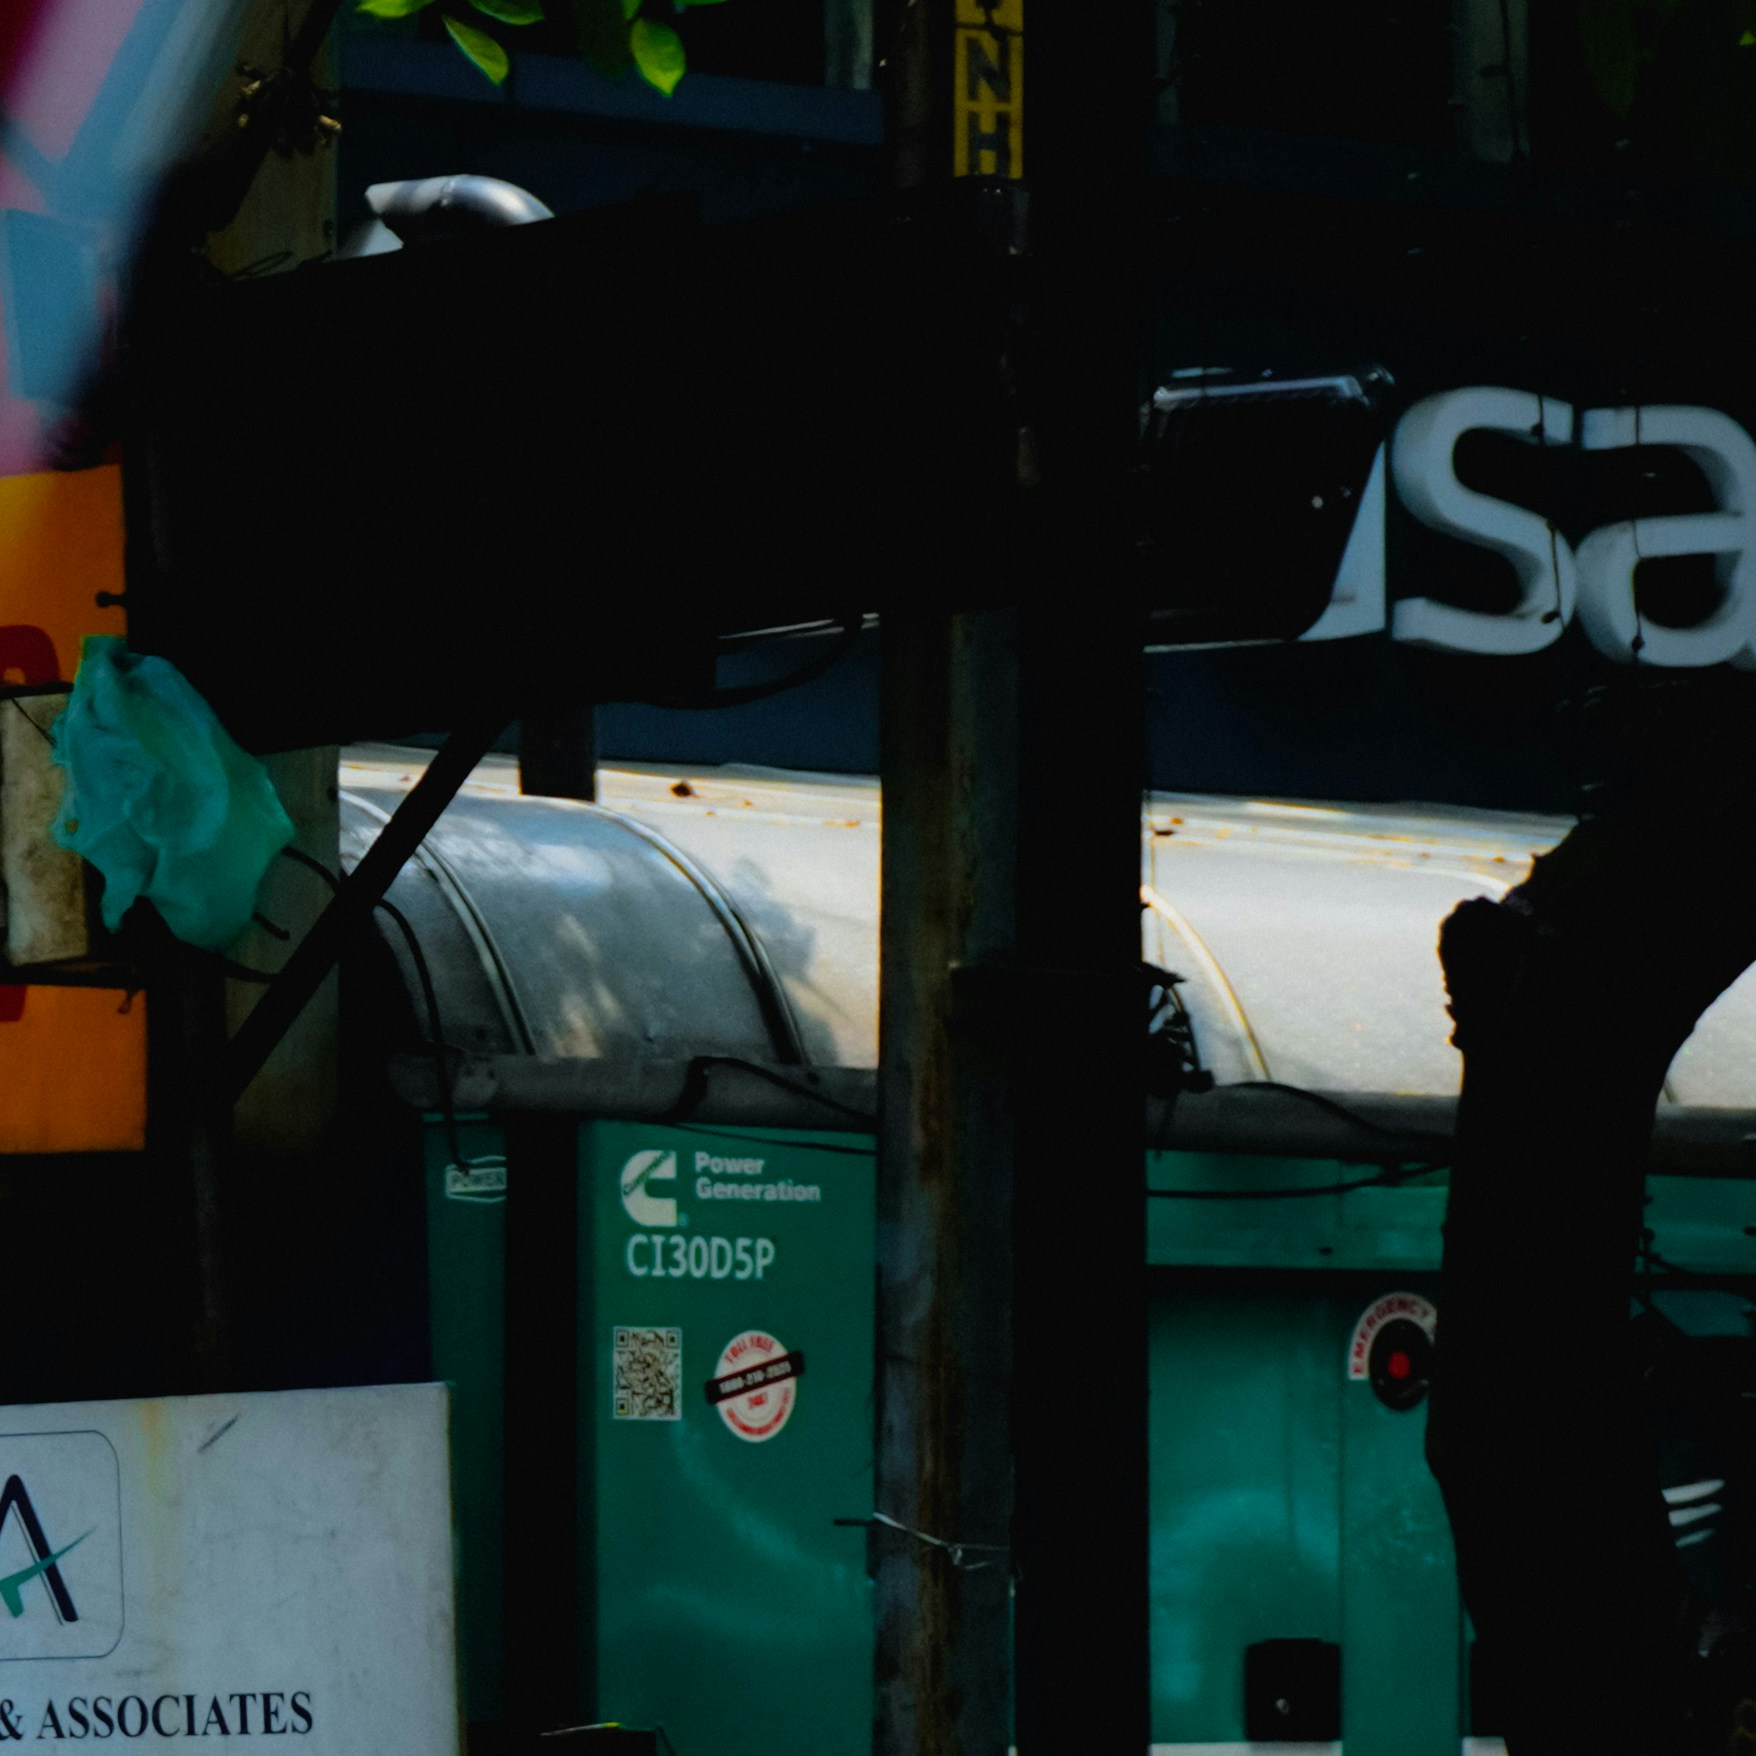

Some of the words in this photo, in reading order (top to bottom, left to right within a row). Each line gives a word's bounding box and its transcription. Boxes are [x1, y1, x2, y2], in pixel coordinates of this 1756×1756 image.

[695, 1151, 765, 1176] Power
[695, 1177, 822, 1203] Generation
[626, 1234, 775, 1281] CI30D5P
[36, 1690, 314, 1742] ASSOCIATES
